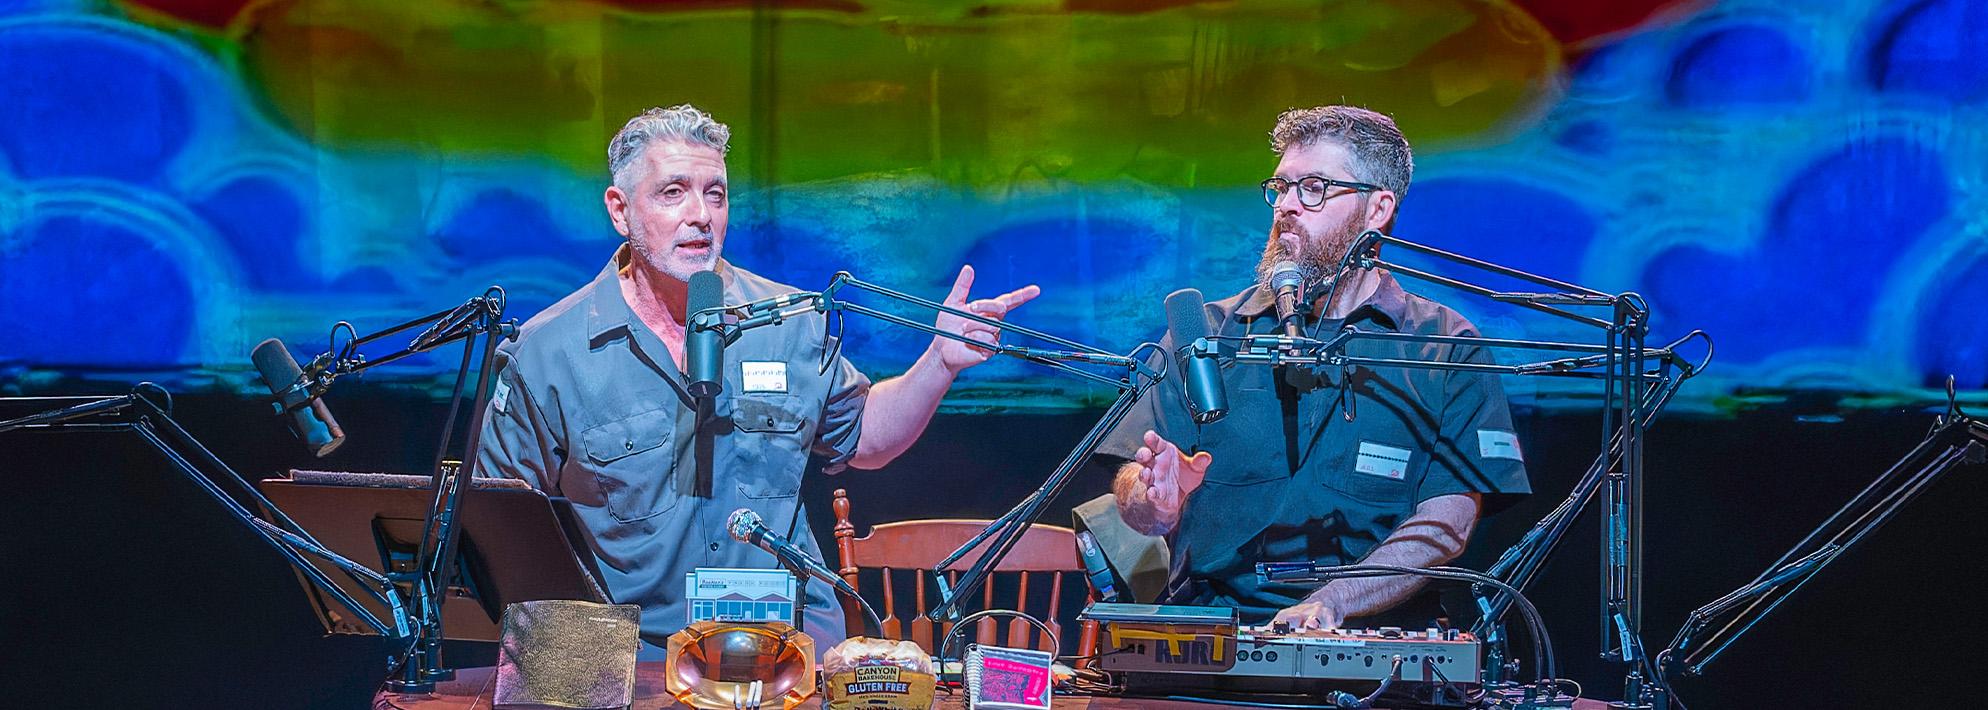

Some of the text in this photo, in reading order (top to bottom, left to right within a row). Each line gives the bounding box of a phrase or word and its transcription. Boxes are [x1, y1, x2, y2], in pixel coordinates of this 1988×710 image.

[858, 667, 896, 675] CANYON
[849, 683, 907, 693] GLUTEN FREE
